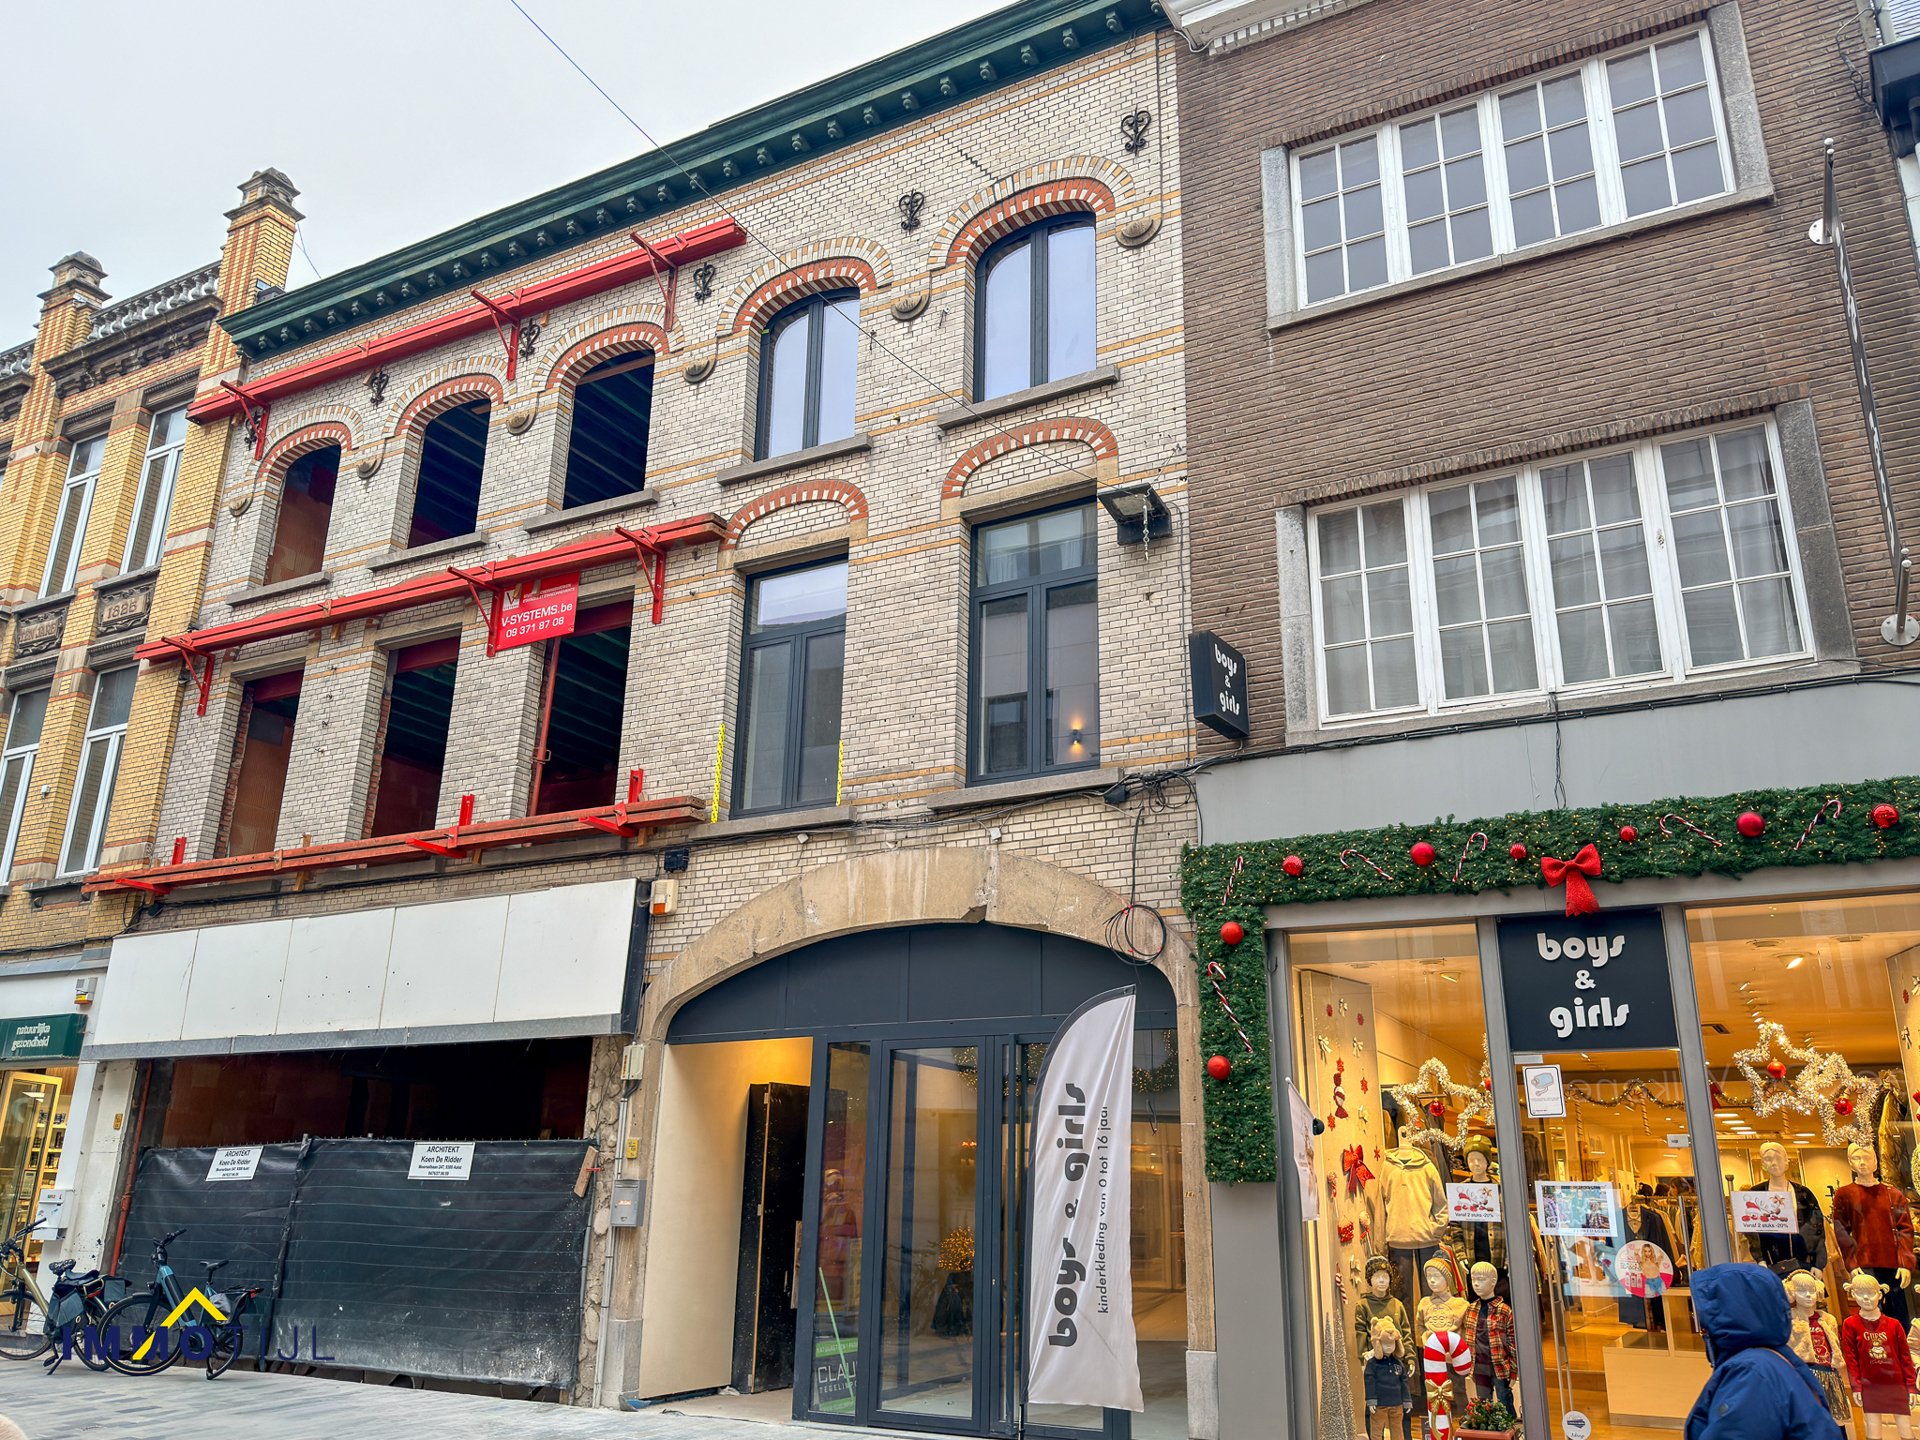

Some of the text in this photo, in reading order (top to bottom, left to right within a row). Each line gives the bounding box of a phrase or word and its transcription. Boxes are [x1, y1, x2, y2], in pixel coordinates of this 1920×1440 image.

[501, 603, 573, 627] V-SYSTEMS.be
[505, 616, 564, 638] 09 371 87 08
[1214, 643, 1238, 677] boys
[1224, 674, 1231, 688] &
[1219, 690, 1240, 716] girls
[1536, 932, 1626, 968] boys
[1574, 969, 1597, 990] &
[1549, 996, 1630, 1039] girls
[11, 1035, 51, 1052] gezondheid
[427, 1145, 460, 1153] ARCHITEKT
[1097, 1135, 1108, 1150] 16
[421, 1155, 435, 1163] Koen
[1099, 1156, 1108, 1174] tot
[1048, 1083, 1090, 1347] boys & girls
[1095, 1222, 1108, 1314] kinderkleding
[1863, 1331, 1888, 1342] GUESS
[818, 1361, 858, 1384] CLAU
